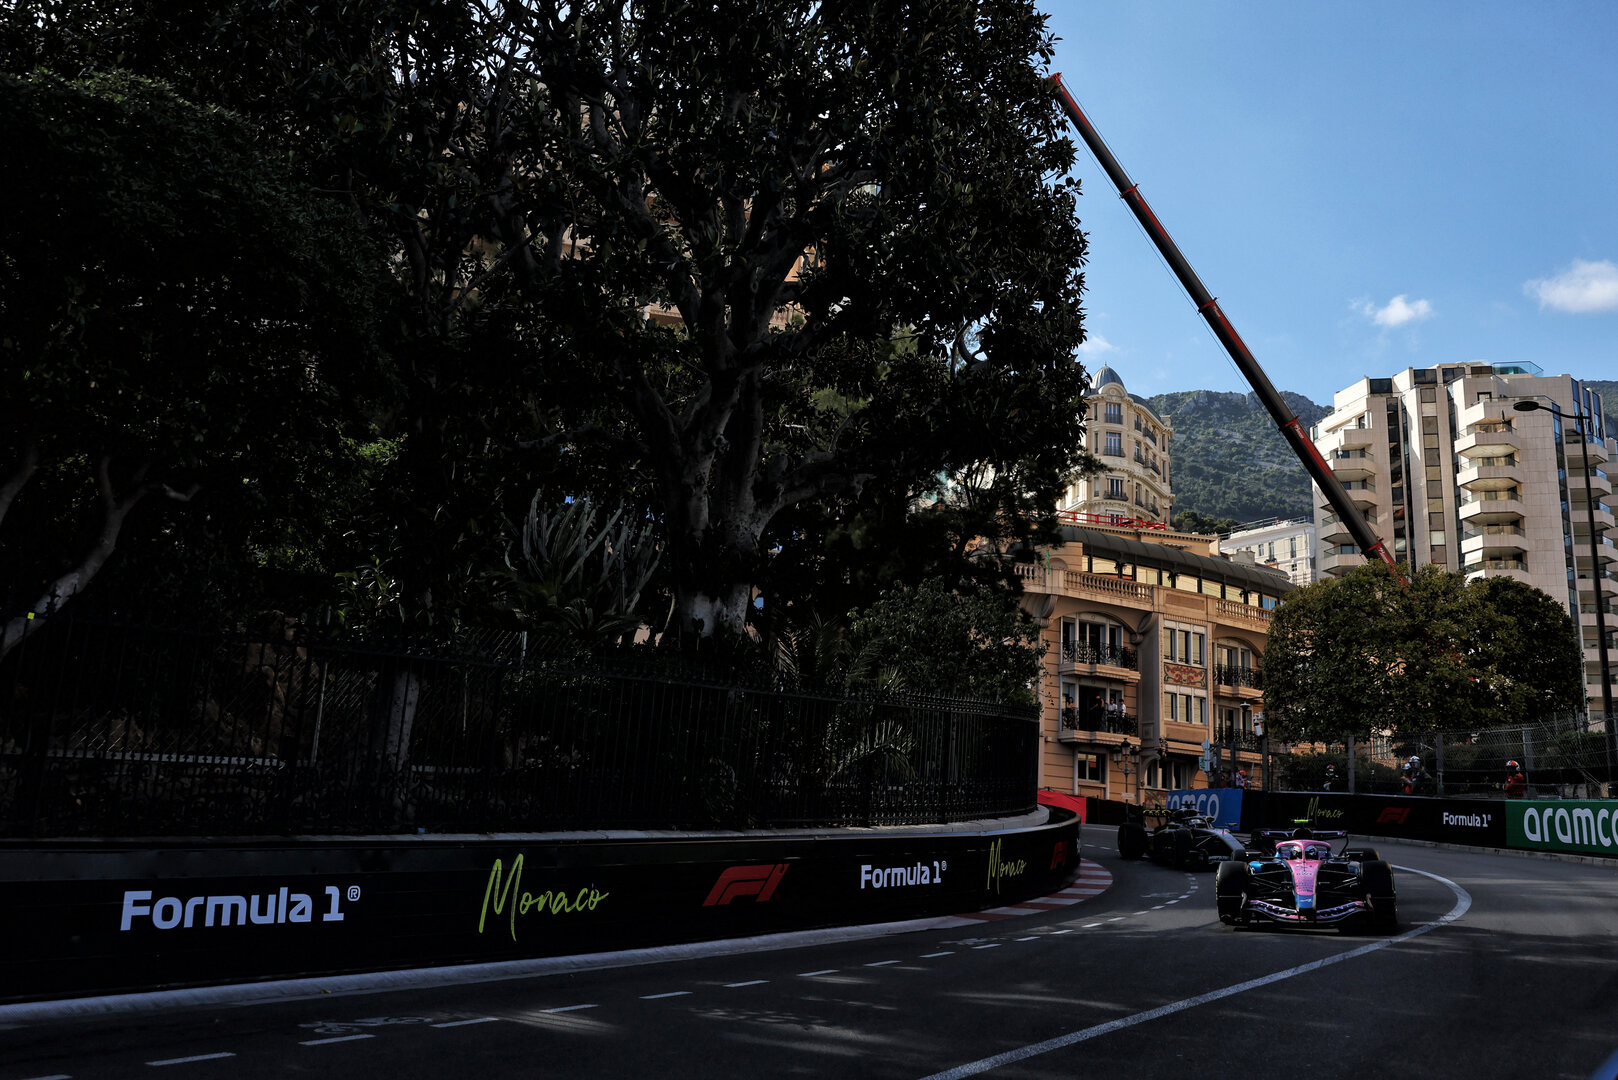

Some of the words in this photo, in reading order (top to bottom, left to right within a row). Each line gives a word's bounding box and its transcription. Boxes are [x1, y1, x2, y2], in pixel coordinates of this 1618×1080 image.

[1306, 796, 1344, 825] Monaco
[1443, 812, 1481, 827] Formula
[860, 862, 930, 889] Formula
[986, 838, 1027, 894] Monaco
[120, 887, 313, 931] Formula
[478, 853, 609, 942] Monaco
